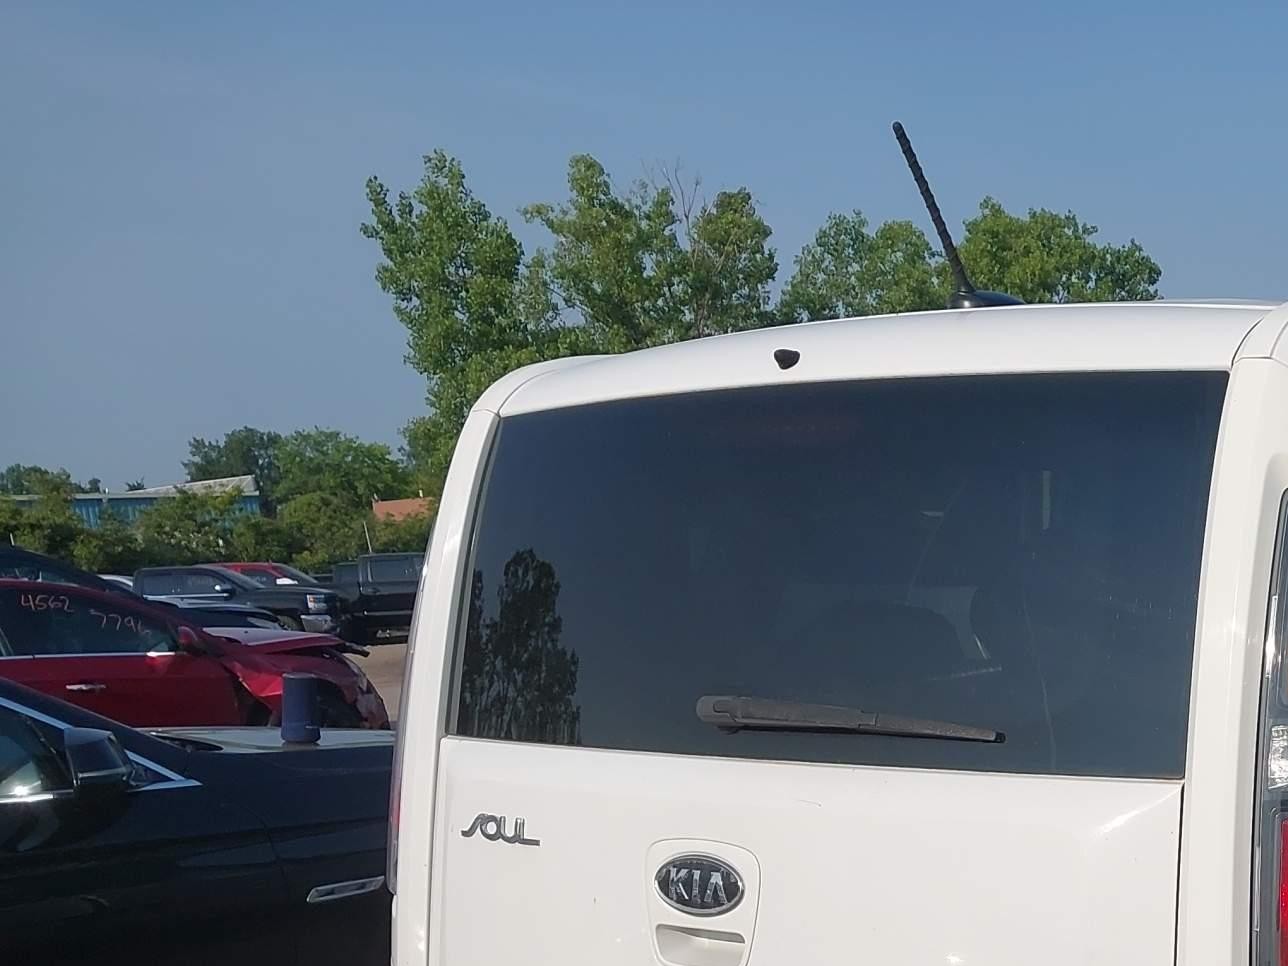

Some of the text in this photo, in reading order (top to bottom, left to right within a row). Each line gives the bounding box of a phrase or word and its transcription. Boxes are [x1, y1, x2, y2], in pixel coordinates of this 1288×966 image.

[20, 594, 75, 613] 4562
[460, 812, 541, 847] SOUL
[667, 865, 729, 904] KIA
